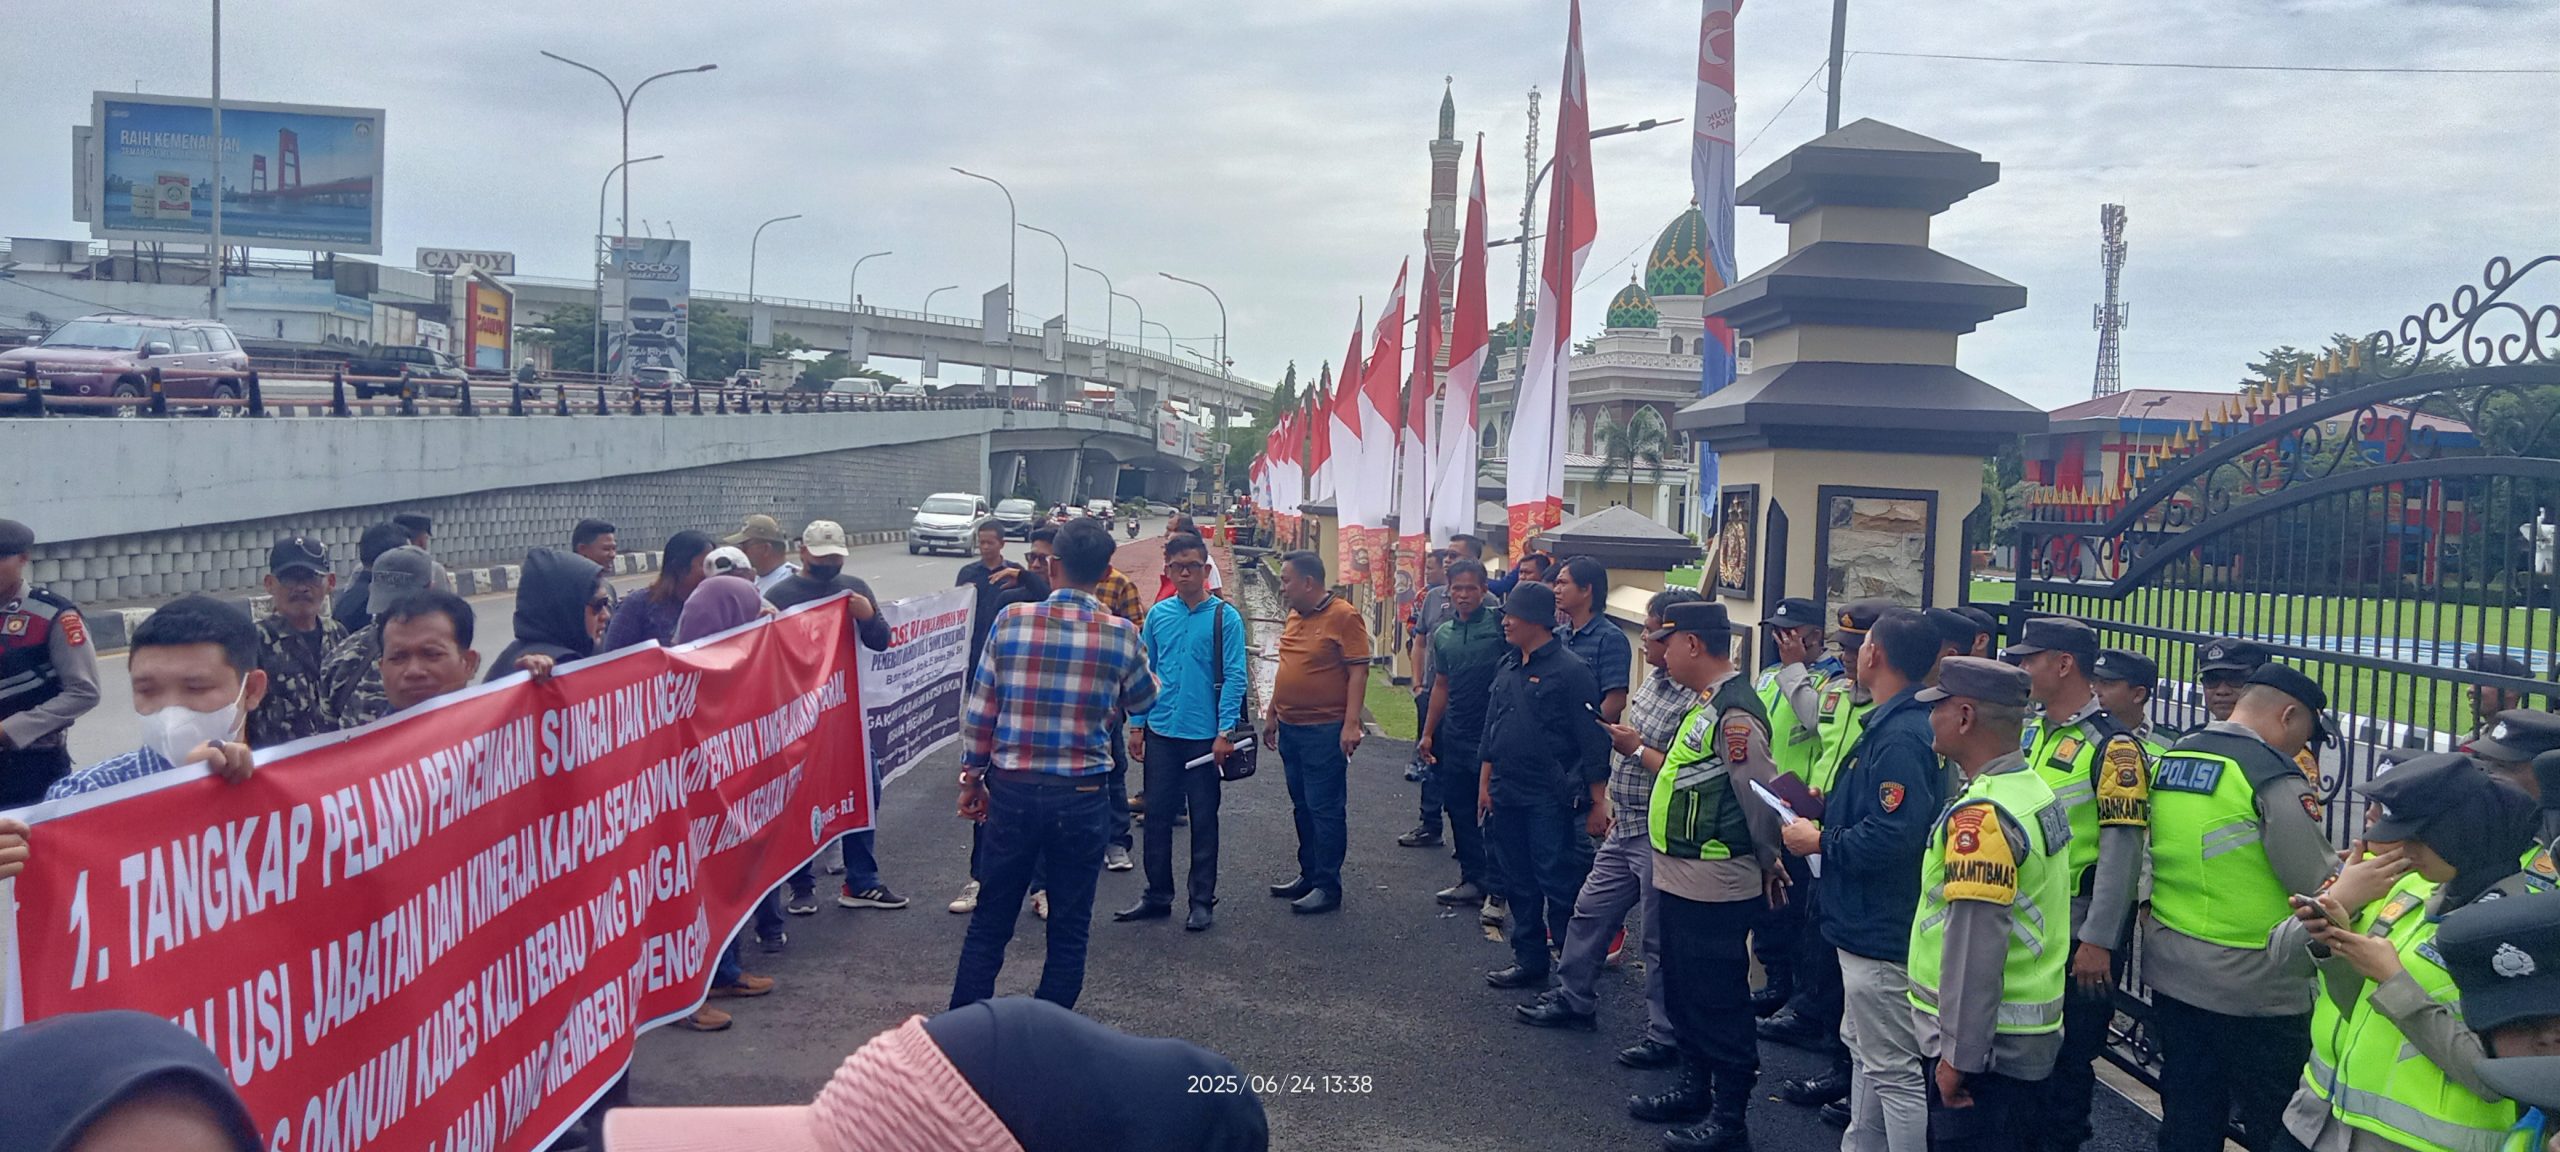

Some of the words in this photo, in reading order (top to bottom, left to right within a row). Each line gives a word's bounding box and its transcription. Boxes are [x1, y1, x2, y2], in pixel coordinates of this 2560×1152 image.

[120, 129, 152, 147] RAIH
[422, 251, 508, 272] CANDY
[887, 621, 909, 648] OSE
[2157, 760, 2218, 792] POLISI
[69, 869, 110, 991] 1.
[120, 803, 312, 968] TANGKAP
[320, 764, 423, 888] PELAKU
[419, 714, 536, 836] PENCEMARAN
[541, 692, 613, 776] SUNGAI
[615, 681, 646, 749] DAN
[304, 894, 422, 1047] JABATAN
[427, 866, 463, 967] DAN
[467, 824, 539, 934] KINERJA
[300, 1035, 410, 1152] OKNUM
[415, 980, 478, 1108] KADES
[481, 945, 524, 1045] KALI
[525, 905, 587, 1007] BERAU
